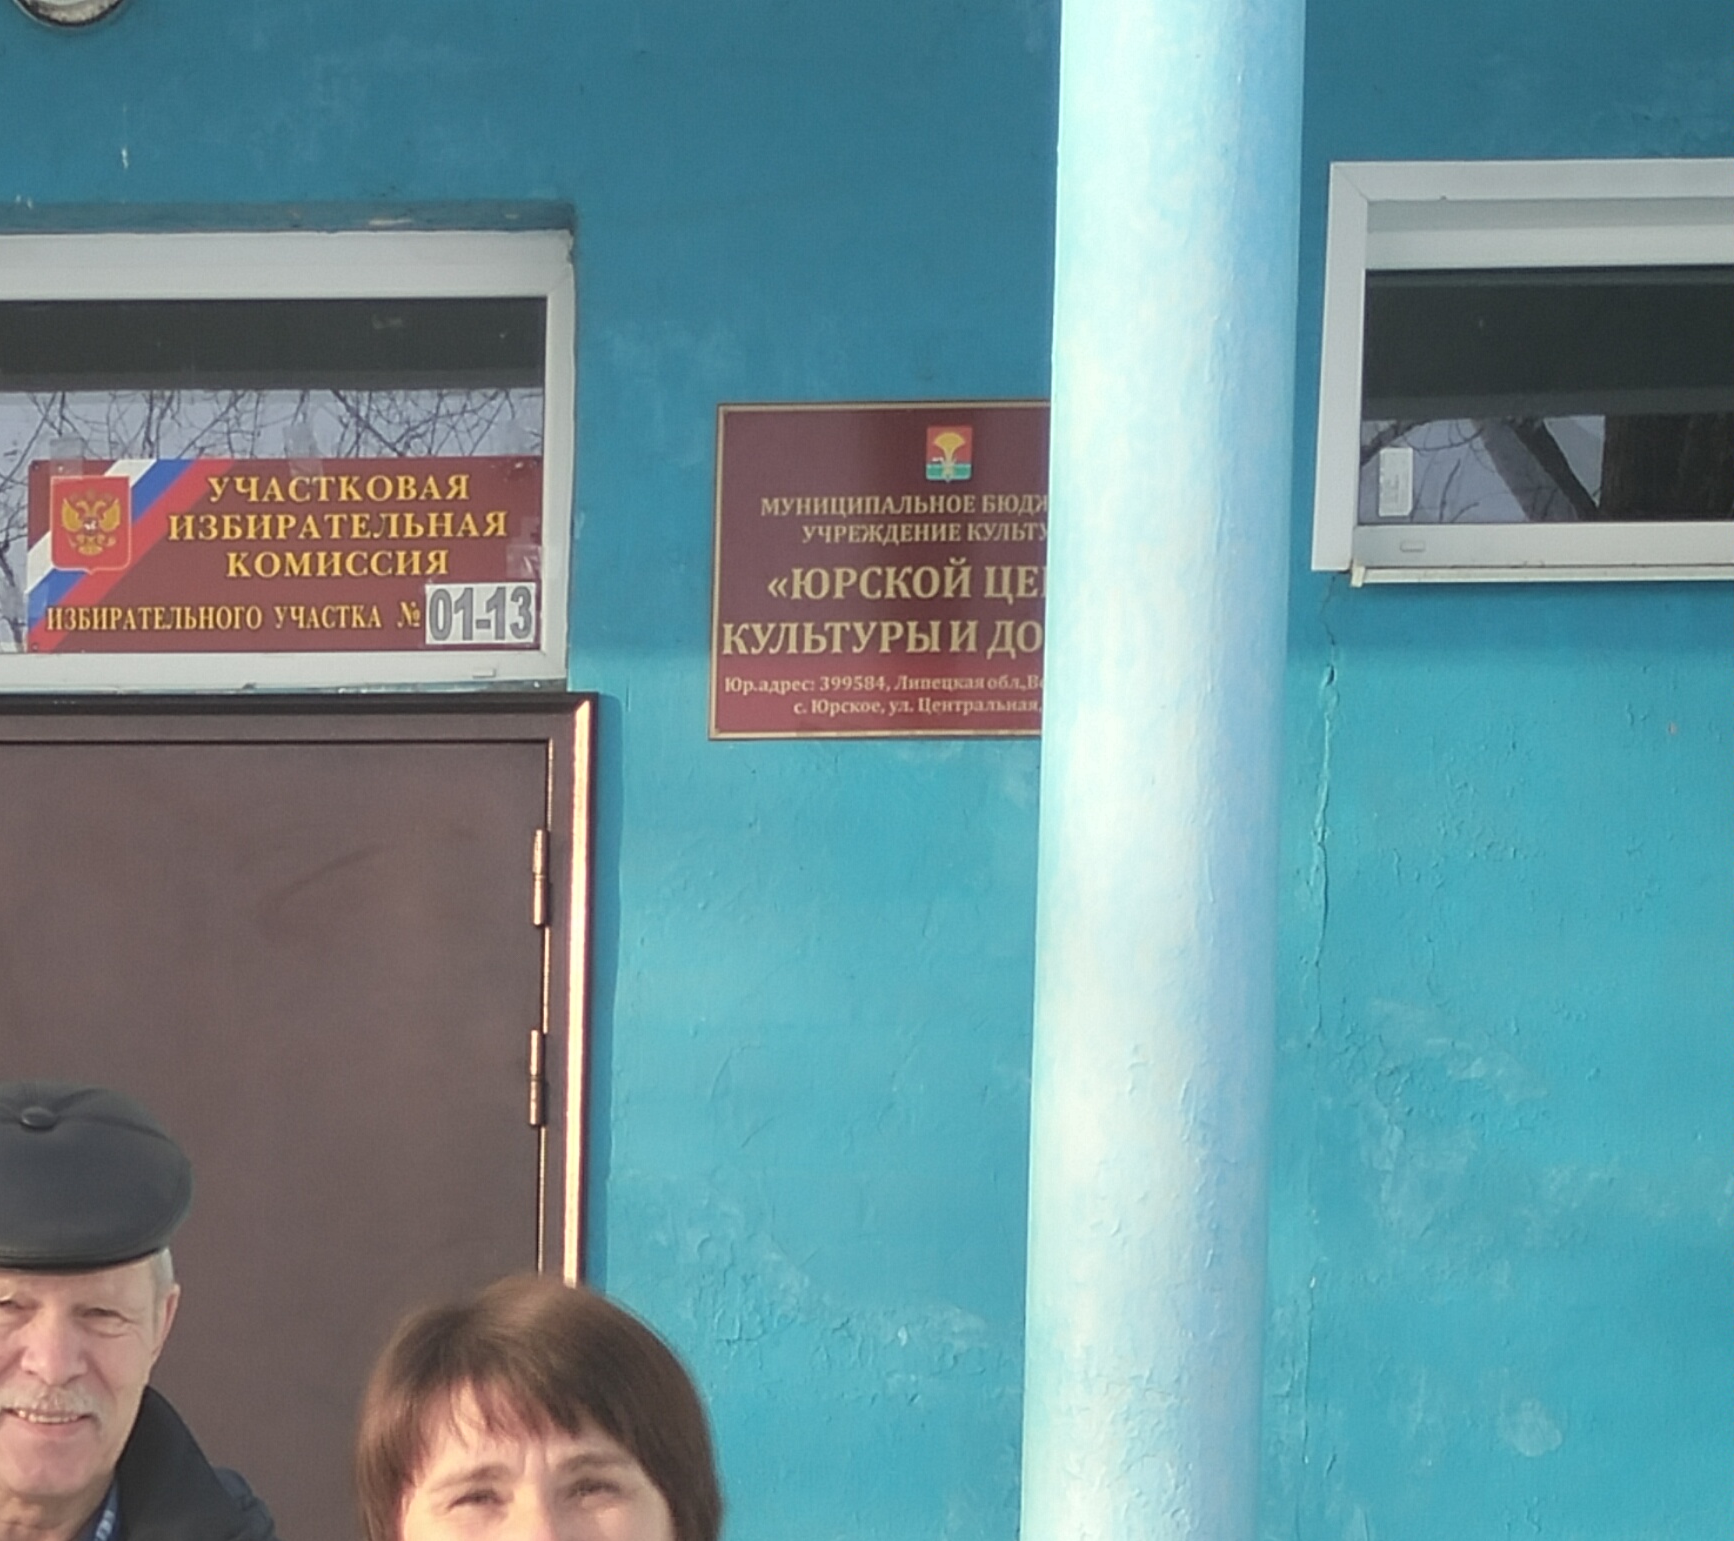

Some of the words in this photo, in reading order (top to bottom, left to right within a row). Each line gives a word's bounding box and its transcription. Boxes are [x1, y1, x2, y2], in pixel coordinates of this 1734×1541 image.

[208, 474, 470, 502] УЧАСТКОВАЯ
[760, 494, 976, 518] МУНИЦИПАЛЬНОЕ
[168, 511, 508, 541] ИЗБИРАТЕЛЬНАЯ
[801, 522, 962, 547] УЧРЕЖДЕНИЕ
[226, 550, 449, 578] КОМИССИЯ
[767, 556, 972, 600] «ЮРСКОЙ
[983, 565, 1047, 606] ЦЕ
[46, 605, 263, 631] ИЗБИРАТЕЛЬНОГО
[274, 604, 382, 629] УЧАСТКА
[397, 601, 422, 628] №
[428, 585, 533, 641] 01-13
[722, 620, 942, 655] КУЛЬТУРЫ
[949, 620, 979, 653] И
[819, 675, 892, 693] 399584,
[894, 674, 985, 692] Липецкая
[811, 698, 886, 718] Юрское,
[889, 701, 915, 717] ул.
